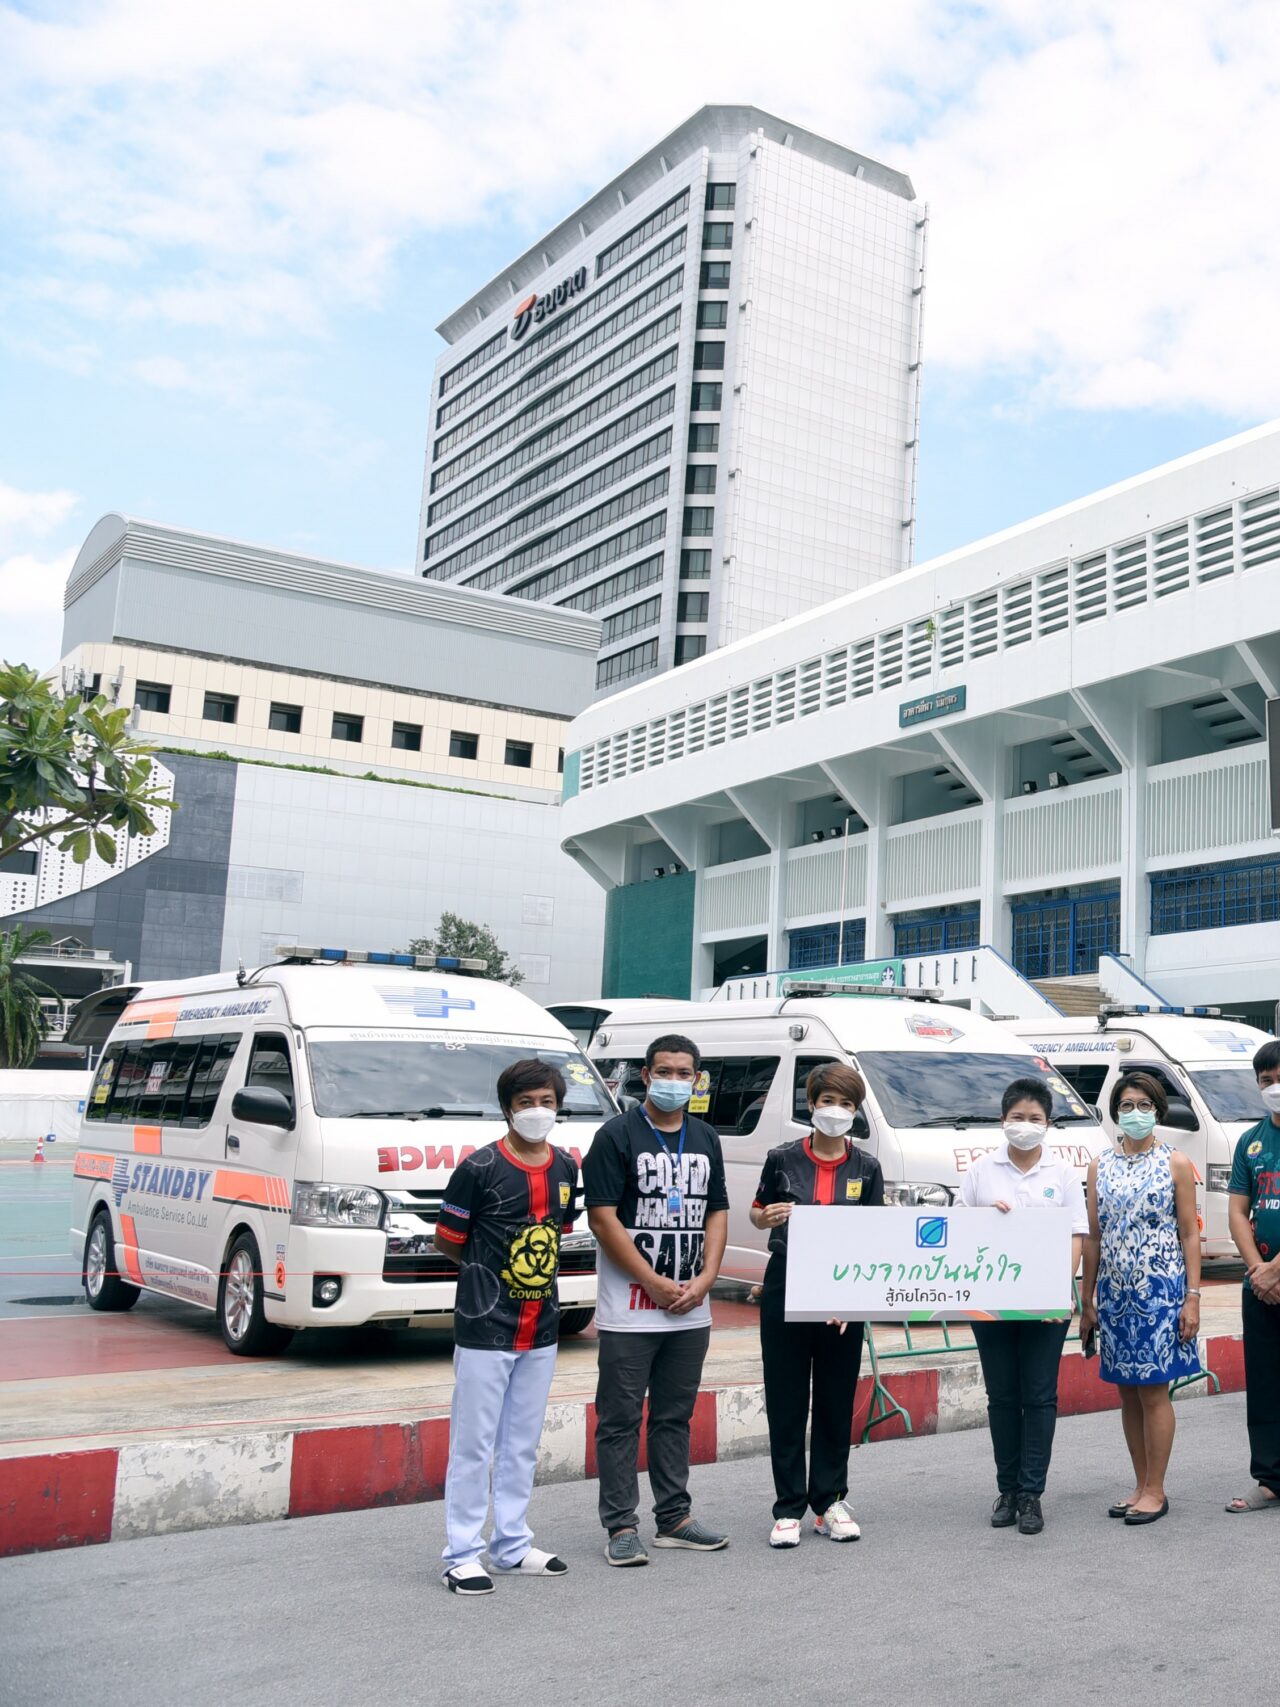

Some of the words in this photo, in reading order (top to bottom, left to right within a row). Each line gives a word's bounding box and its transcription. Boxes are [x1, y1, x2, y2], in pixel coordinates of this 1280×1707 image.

[178, 1006, 221, 1022] EMERGENCY
[222, 1000, 272, 1017] AMBULANCE
[1065, 1041, 1117, 1053] AMBULANCE
[130, 1161, 213, 1203] STANDBY
[637, 1152, 711, 1195] COVID
[127, 1200, 160, 1219] Ambulance
[160, 1207, 186, 1225] Service
[833, 1246, 1023, 1283] บางจากปันน้ำใจ
[508, 1288, 552, 1300] COVID-19
[885, 1287, 971, 1307] สู้ภัยโควิด-19
